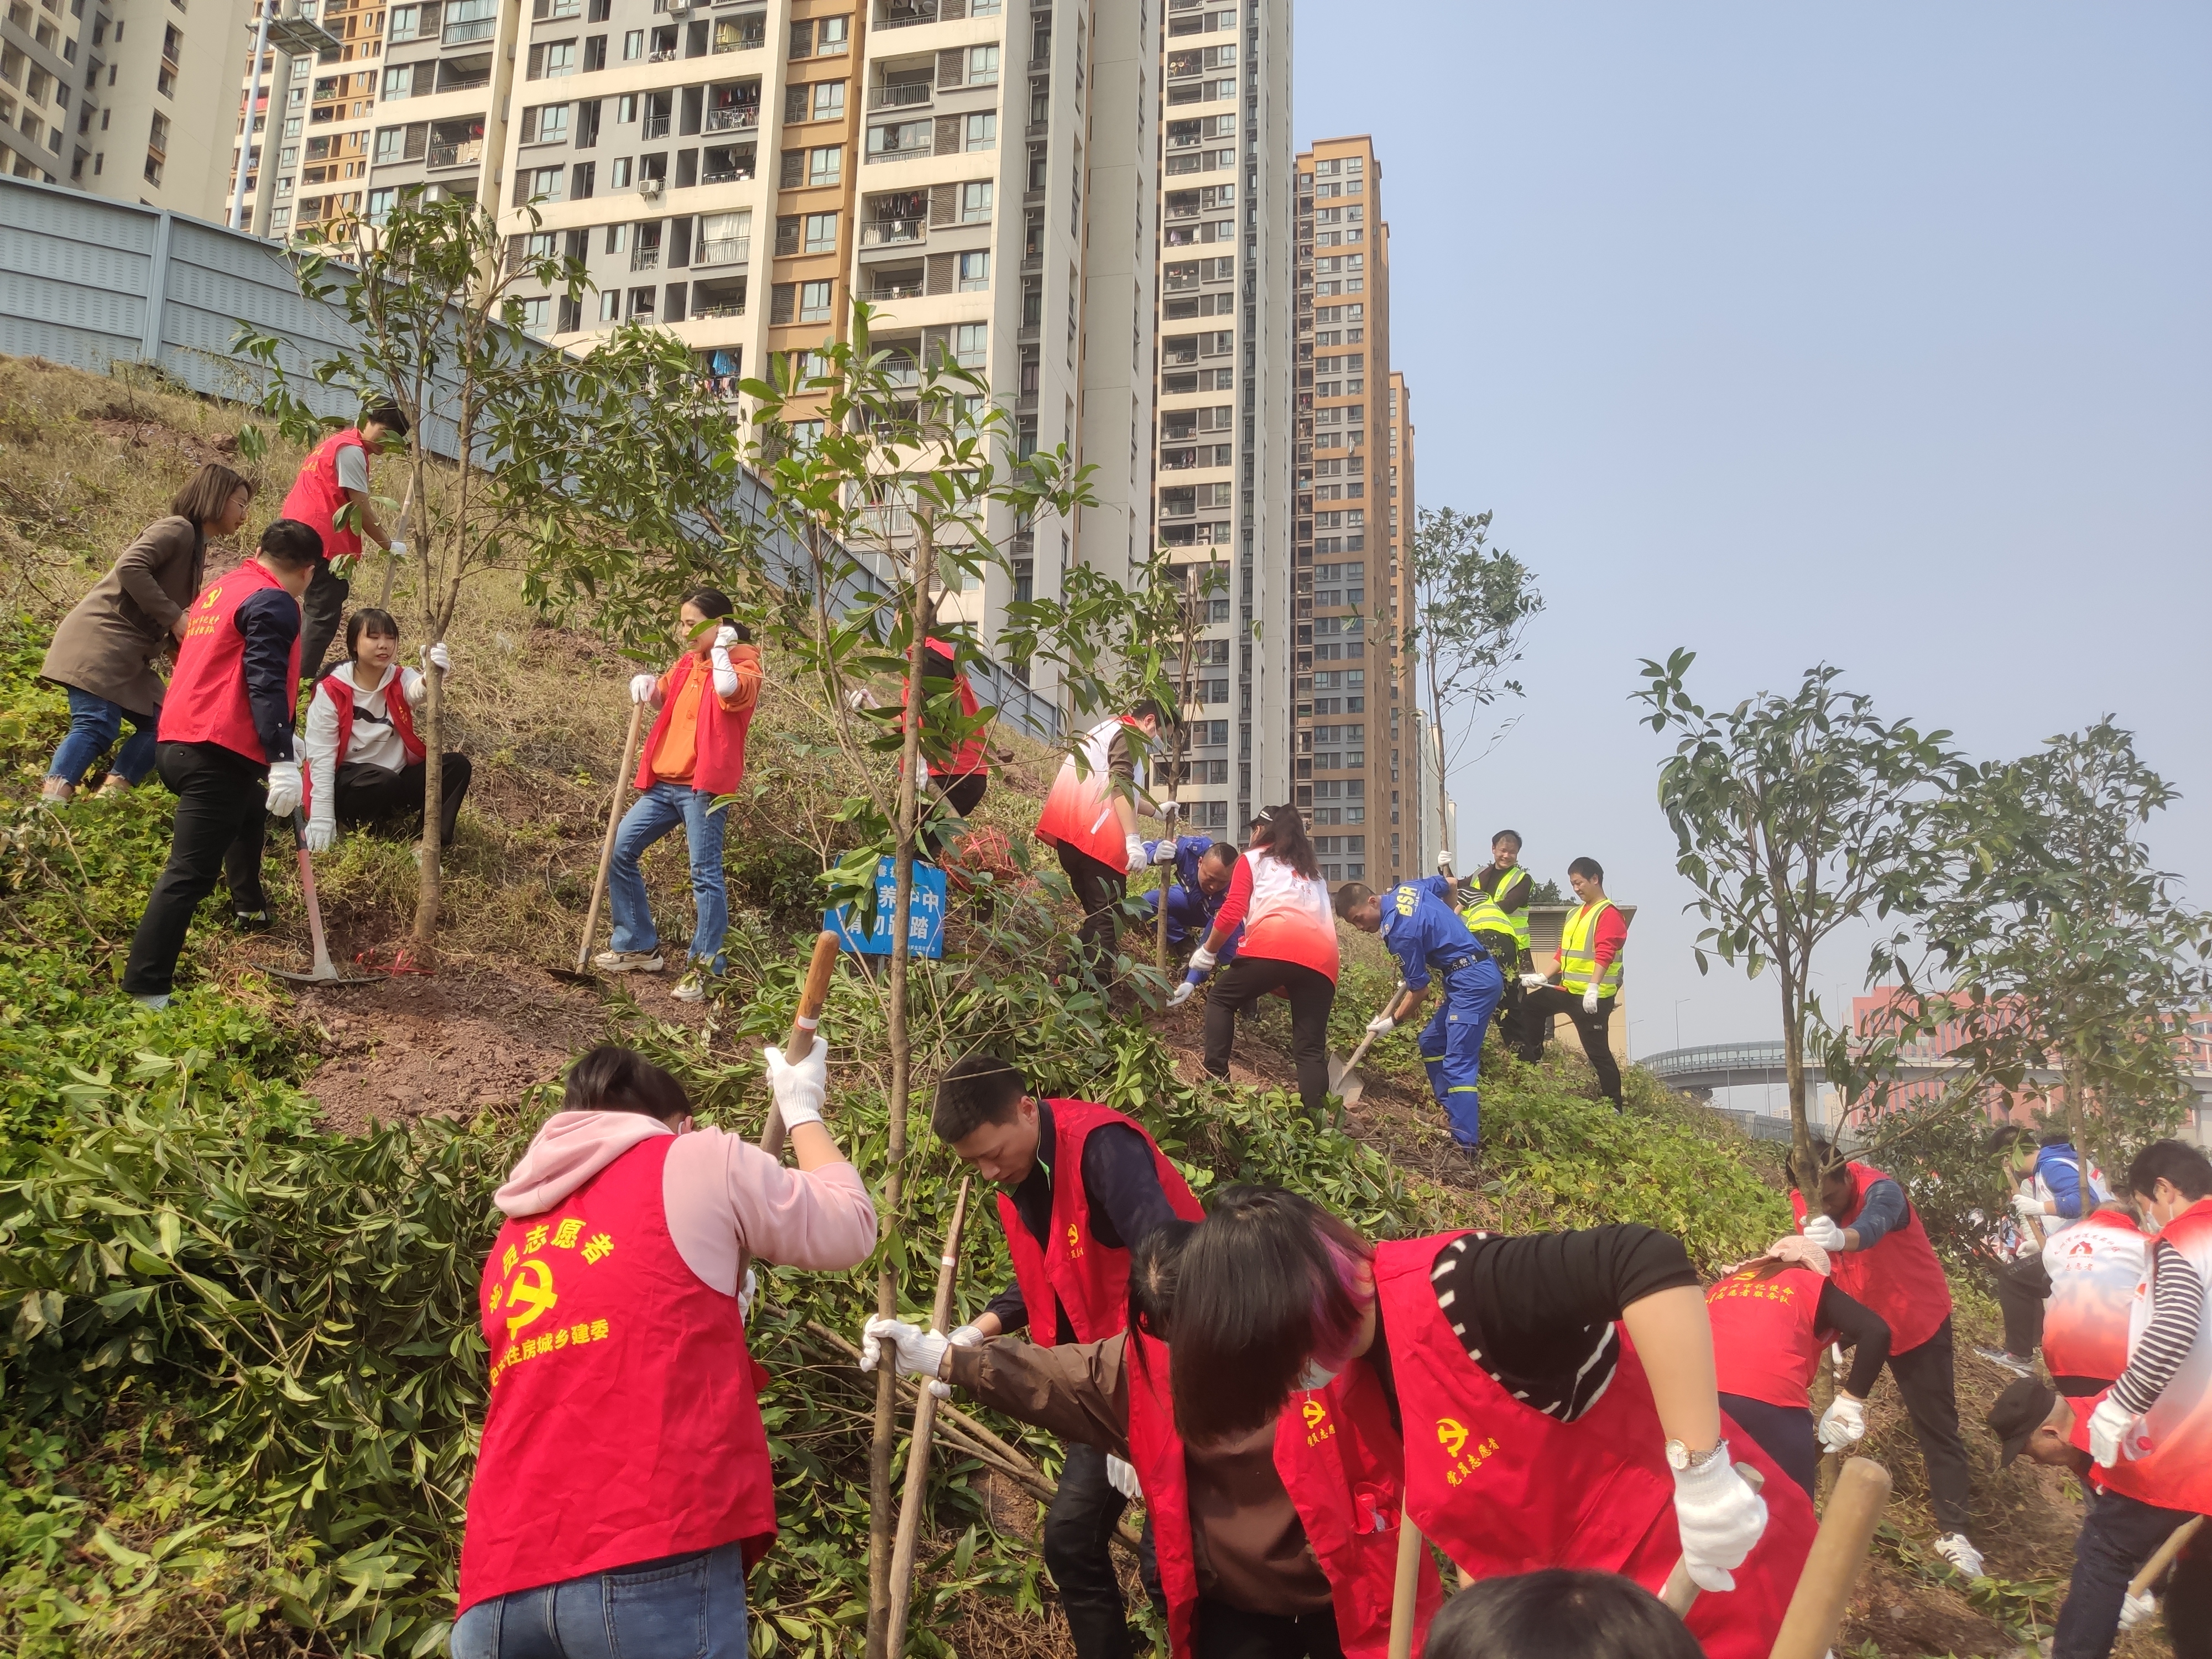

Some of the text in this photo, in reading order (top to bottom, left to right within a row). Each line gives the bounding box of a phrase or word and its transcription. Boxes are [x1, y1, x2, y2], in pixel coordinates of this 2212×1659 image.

[1446, 1437, 1500, 1488] 党员志愿者
